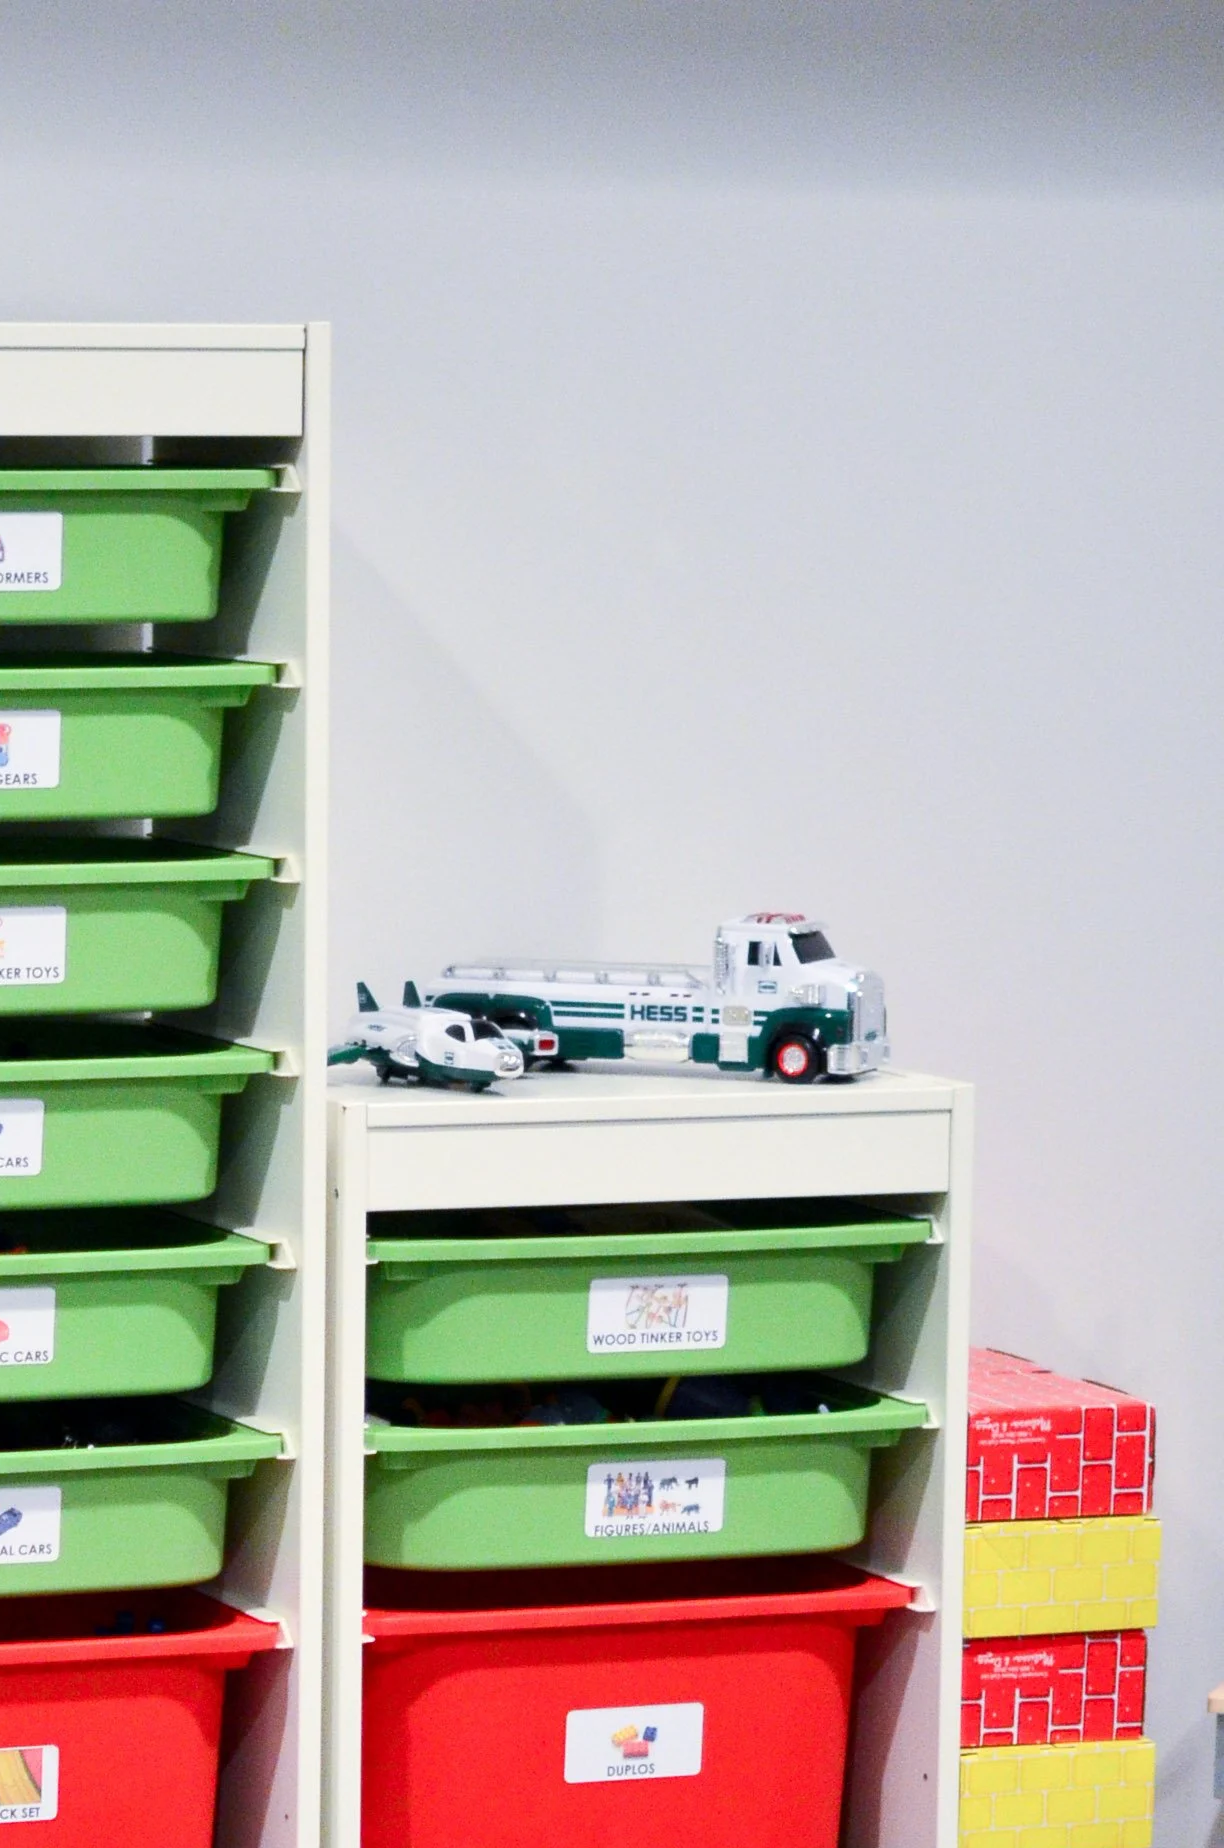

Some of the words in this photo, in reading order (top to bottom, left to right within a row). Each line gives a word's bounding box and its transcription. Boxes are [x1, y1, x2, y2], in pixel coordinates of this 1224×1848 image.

[25, 966, 60, 979] TOYS
[630, 1004, 687, 1022] HESS
[592, 1332, 637, 1346] WOOD
[640, 1331, 682, 1344] TINKER
[684, 1330, 719, 1342] TOYS
[12, 1350, 49, 1363] CARS
[18, 1543, 53, 1556] CARS
[606, 1763, 656, 1777] DUPLOS
[21, 1807, 41, 1819] SET
